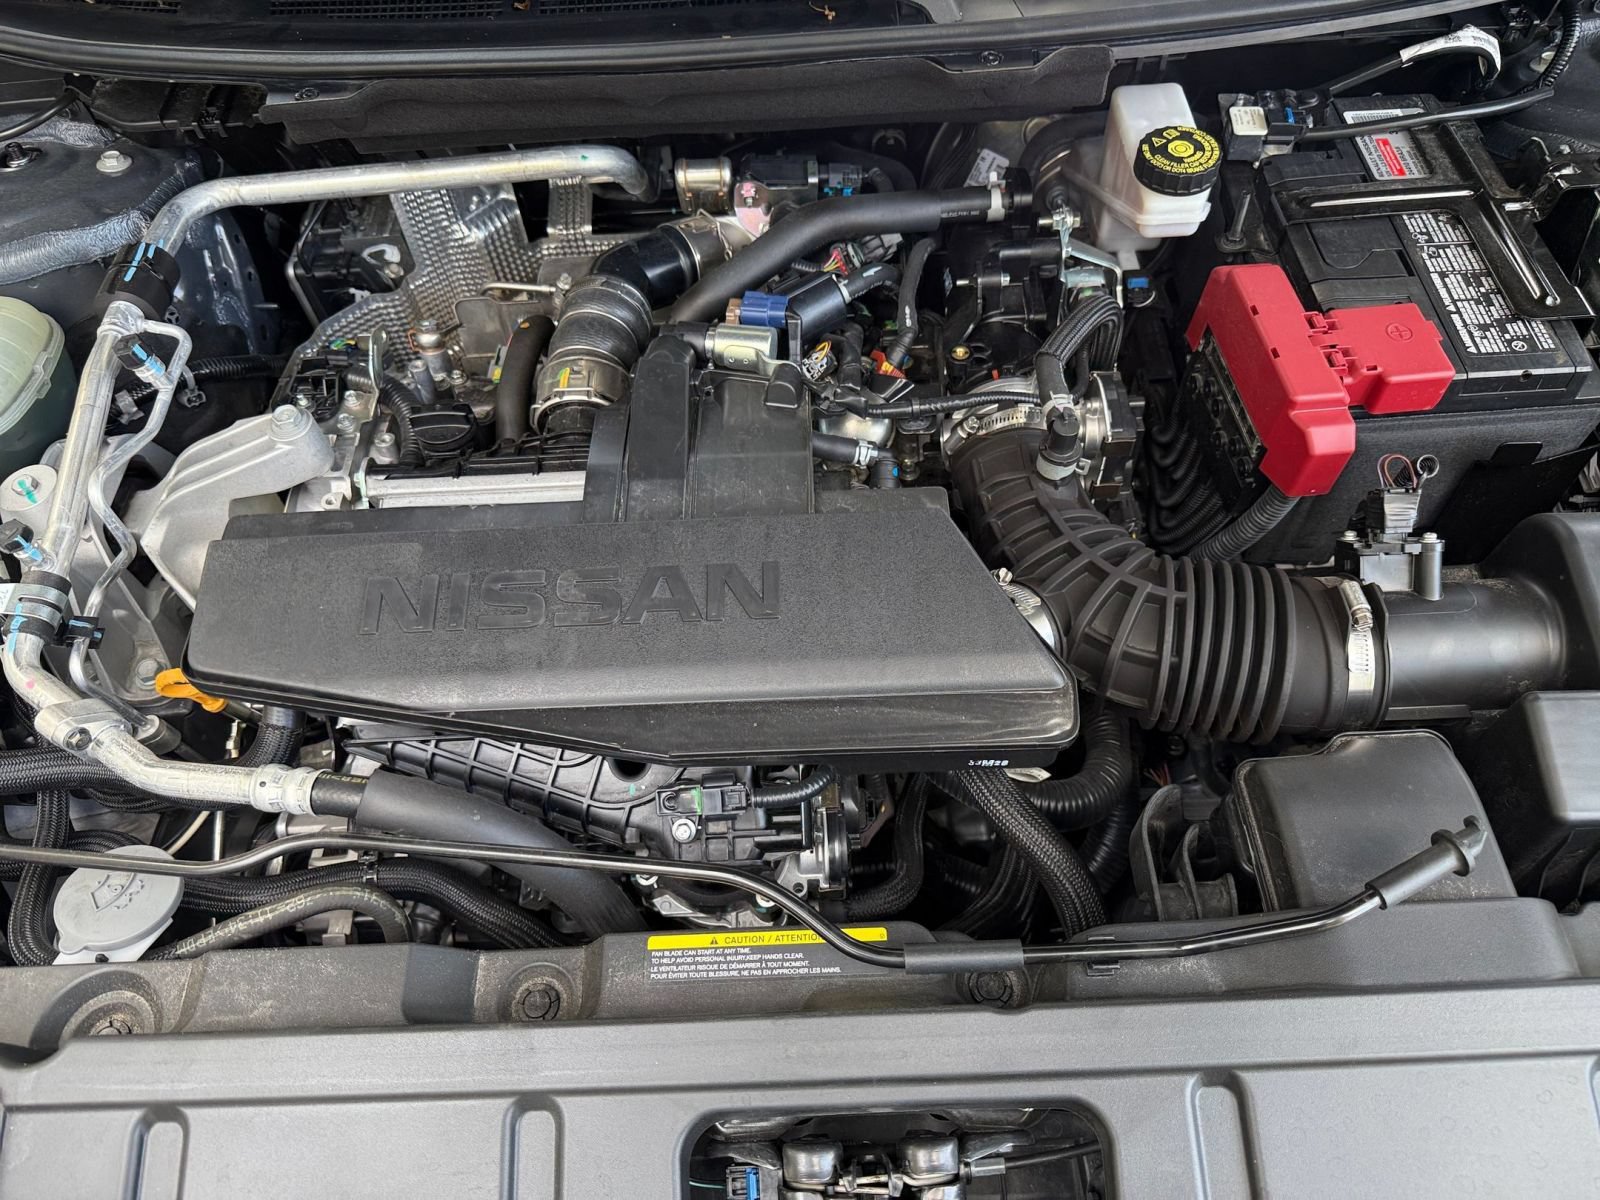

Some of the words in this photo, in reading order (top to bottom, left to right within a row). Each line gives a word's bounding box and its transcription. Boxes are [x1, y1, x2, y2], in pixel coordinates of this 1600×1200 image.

[357, 560, 781, 636] NISSAN
[724, 935, 765, 944] CAUTION
[668, 971, 688, 979] ÉVITER
